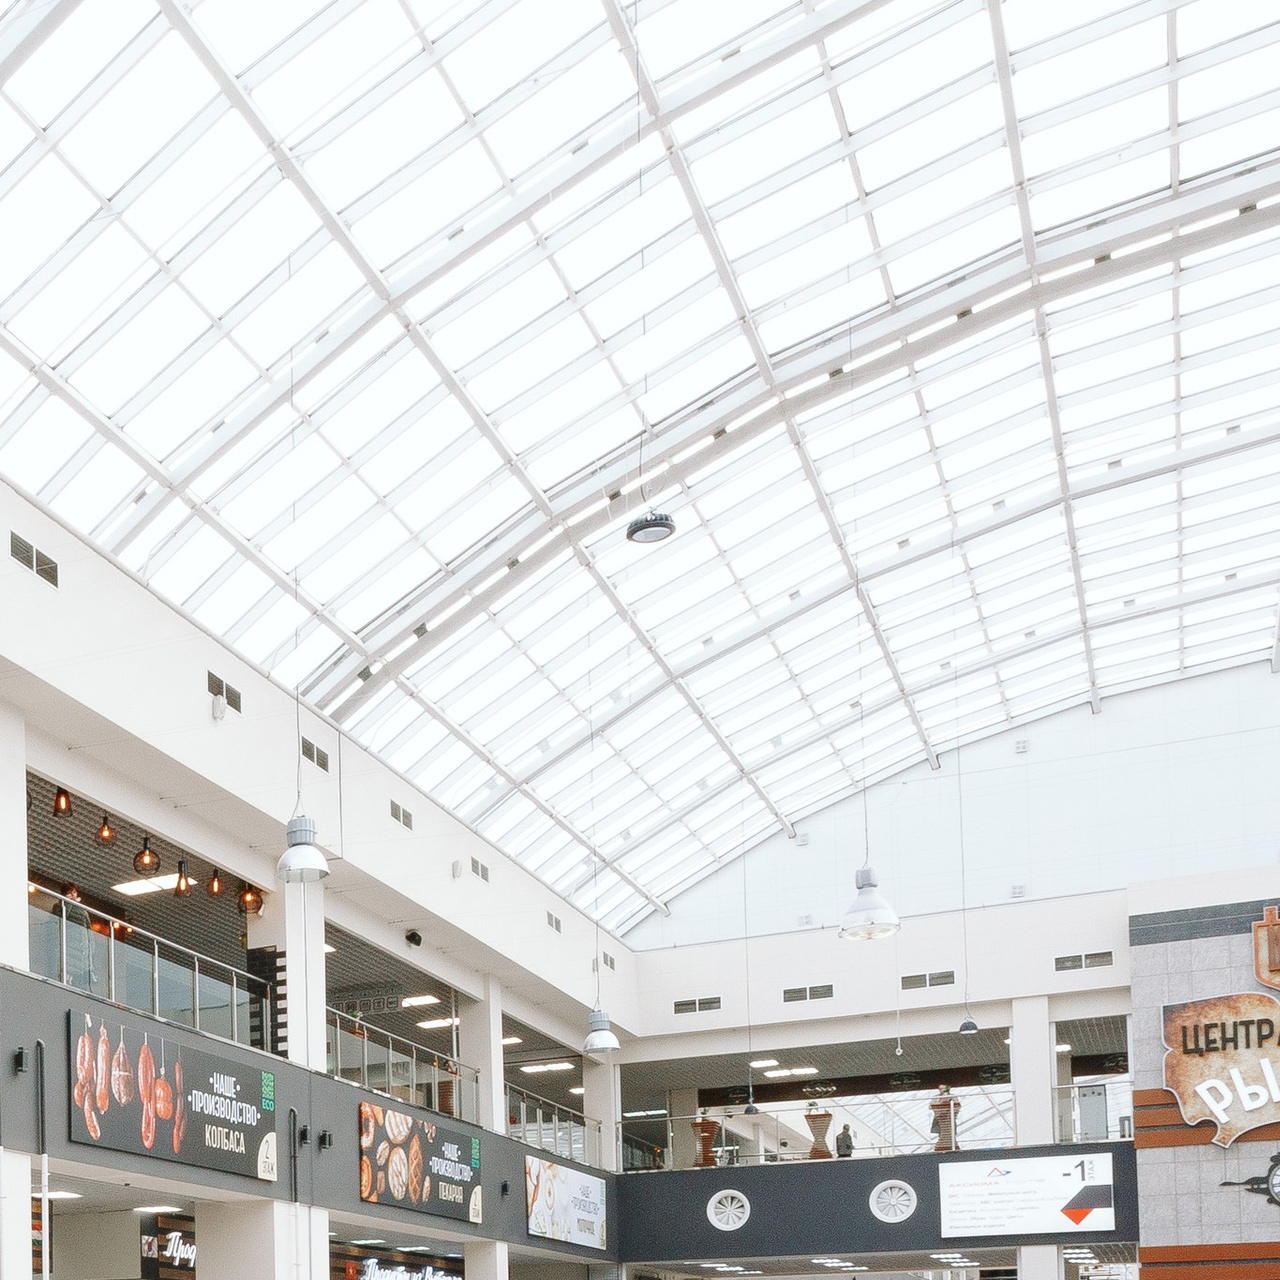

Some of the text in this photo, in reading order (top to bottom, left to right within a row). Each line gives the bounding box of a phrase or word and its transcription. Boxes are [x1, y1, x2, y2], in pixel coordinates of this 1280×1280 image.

[1181, 1018, 1280, 1057] ЦЕНТР
[213, 1072, 237, 1098] НАШЕ
[192, 1089, 257, 1126] ПРОИЗВОДСТВО
[205, 1123, 246, 1154] КОЛБАСА
[264, 1139, 270, 1160] 2
[431, 1156, 471, 1182] ПРОИЗВОДСТВО
